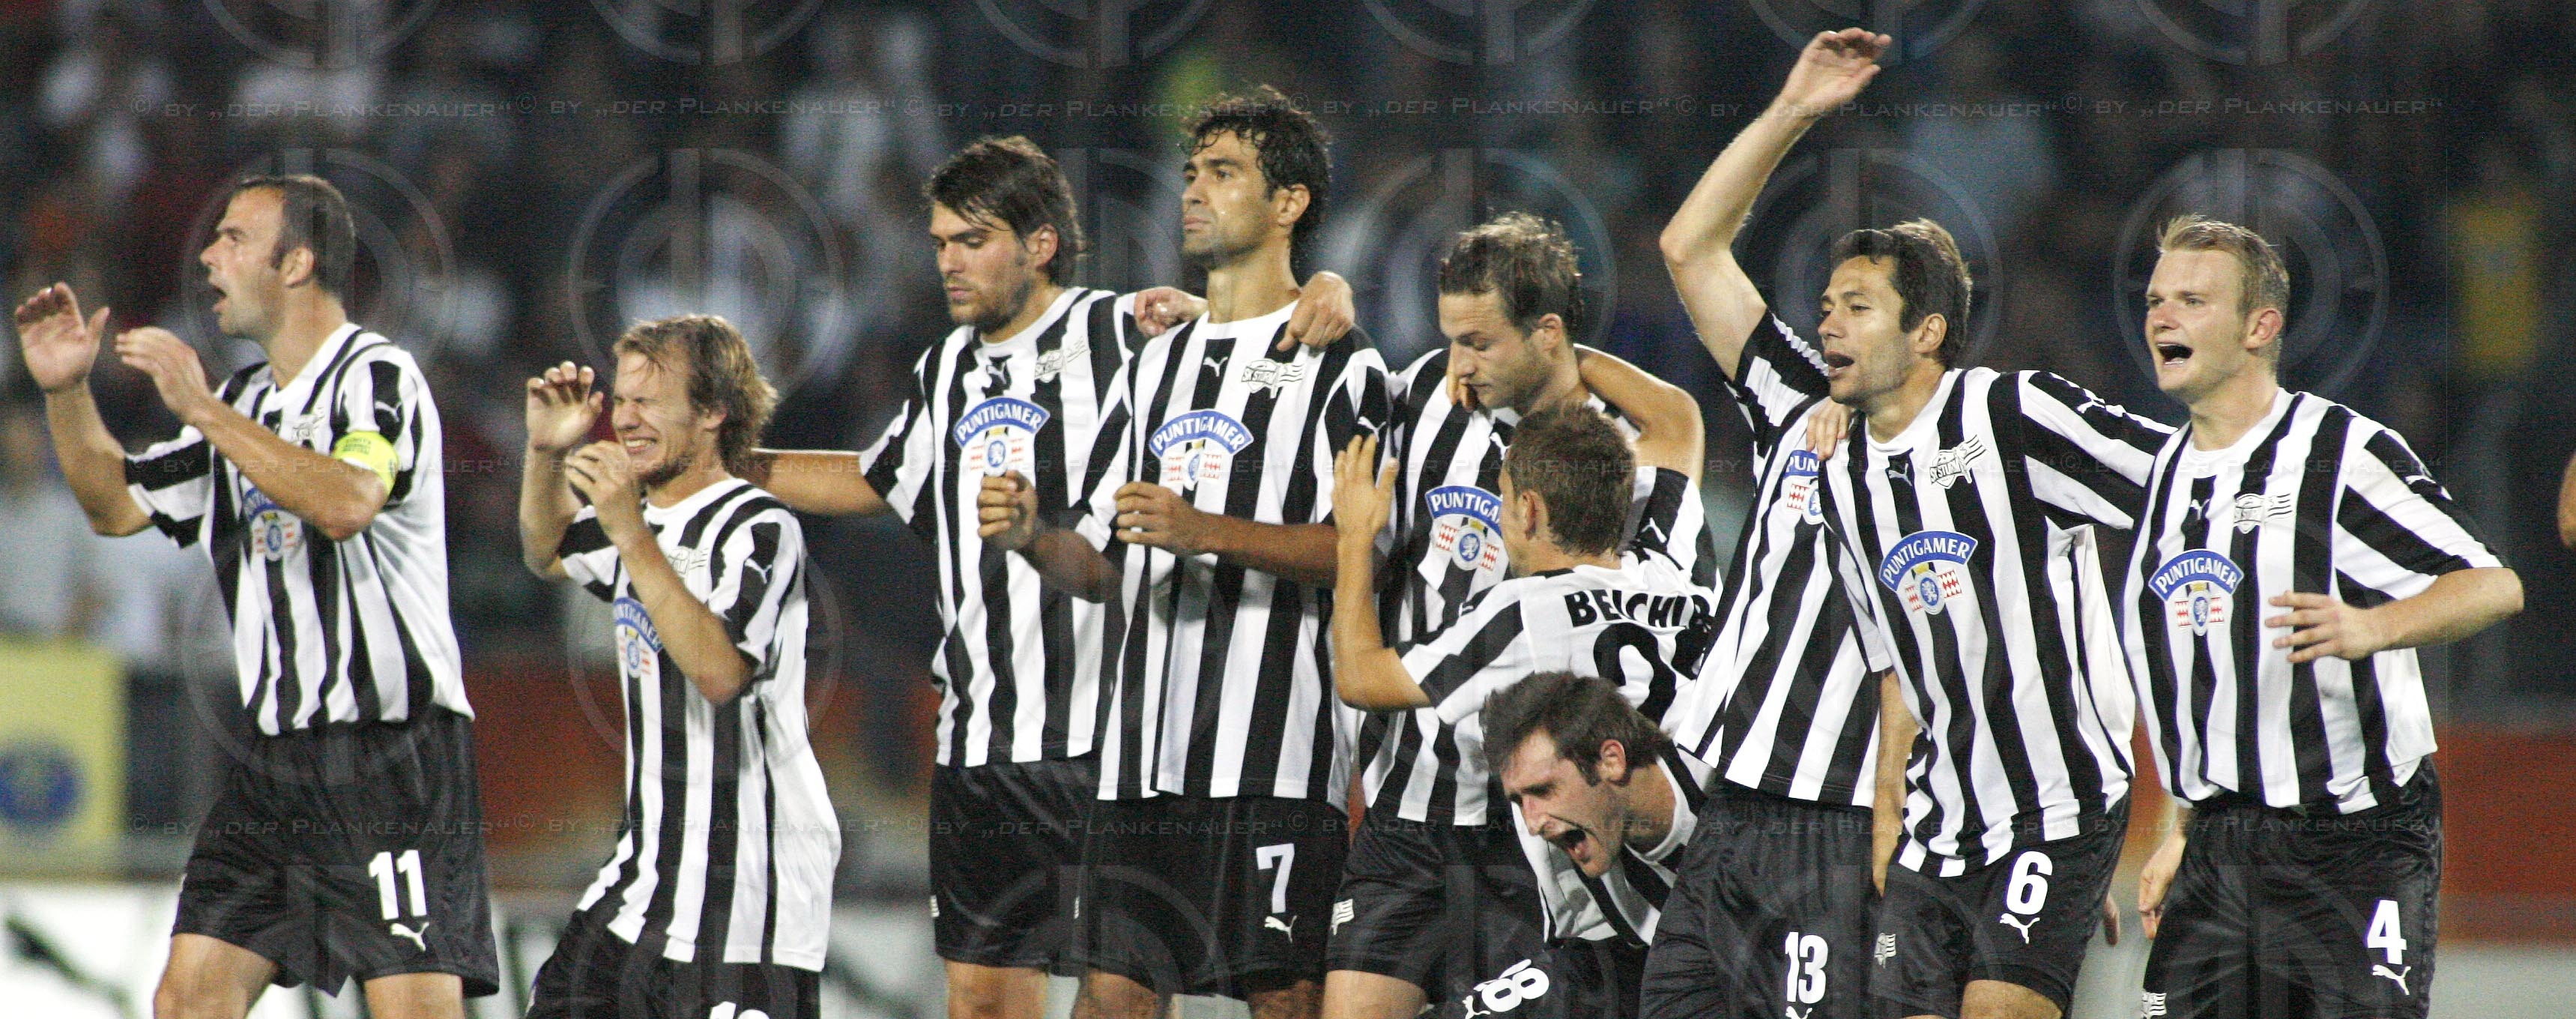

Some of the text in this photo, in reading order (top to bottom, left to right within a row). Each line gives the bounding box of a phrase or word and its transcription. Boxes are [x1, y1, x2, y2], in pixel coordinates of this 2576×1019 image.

[956, 402, 1042, 441] PUNTIGAMER
[1152, 416, 1245, 450] PUNTIGAMER
[1430, 492, 1501, 524] PUNTIGA
[1882, 537, 1971, 584] PUNTIGAMER
[2154, 557, 2237, 592] PUNTIGAMER
[368, 849, 427, 921] 11
[1256, 843, 1295, 913] 7
[2006, 850, 2053, 915] 6
[2366, 899, 2407, 965] 4
[1785, 931, 1828, 1004] 13
